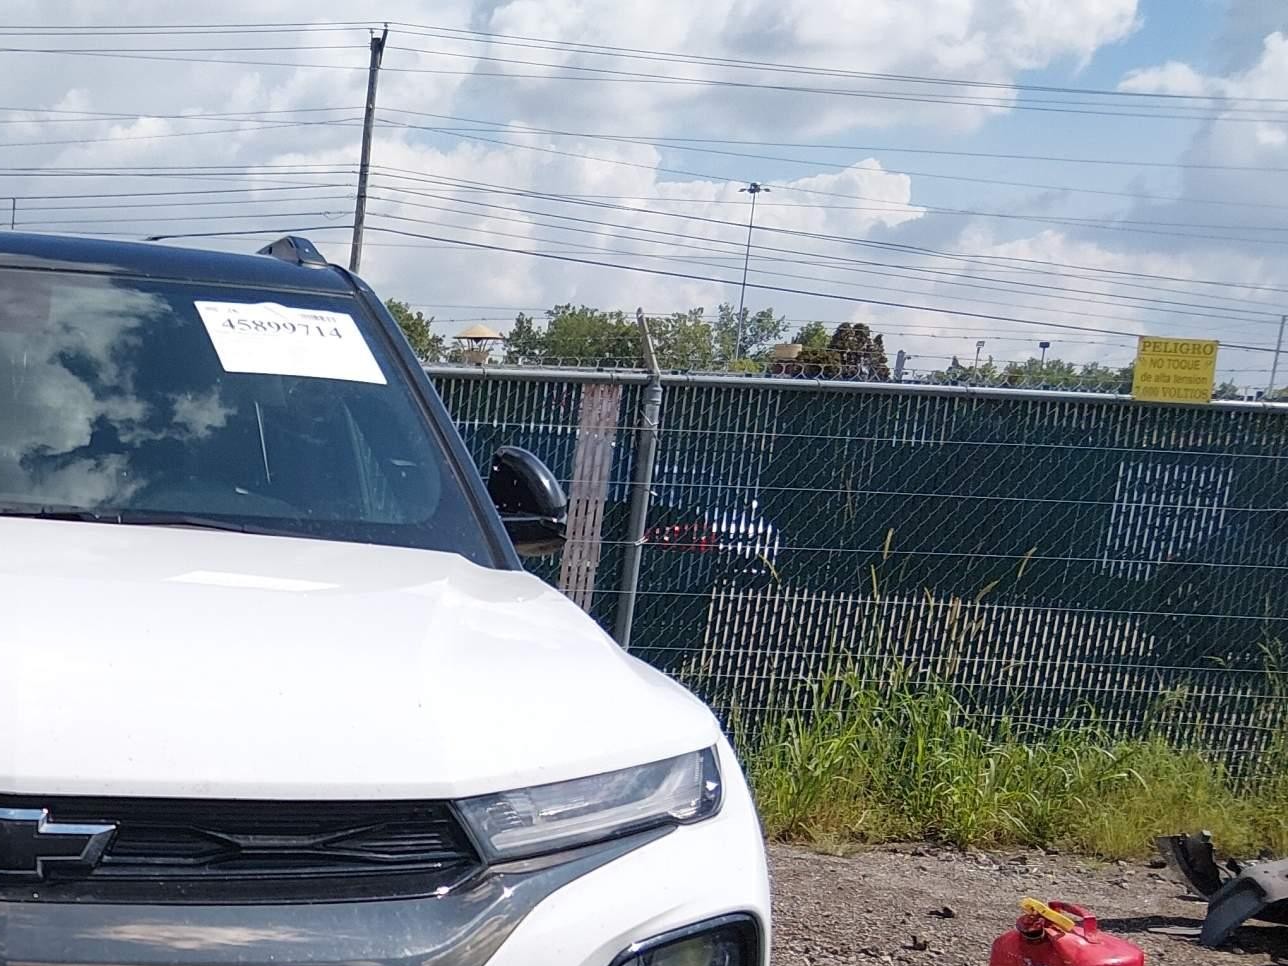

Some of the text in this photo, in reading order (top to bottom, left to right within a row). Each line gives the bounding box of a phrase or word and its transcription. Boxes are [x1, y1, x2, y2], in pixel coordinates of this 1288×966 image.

[222, 318, 342, 339] 45899714
[1141, 340, 1215, 356] PELIGRO
[1149, 358, 1201, 370] NO TOQUE
[1161, 386, 1209, 400] VOLTIOS
